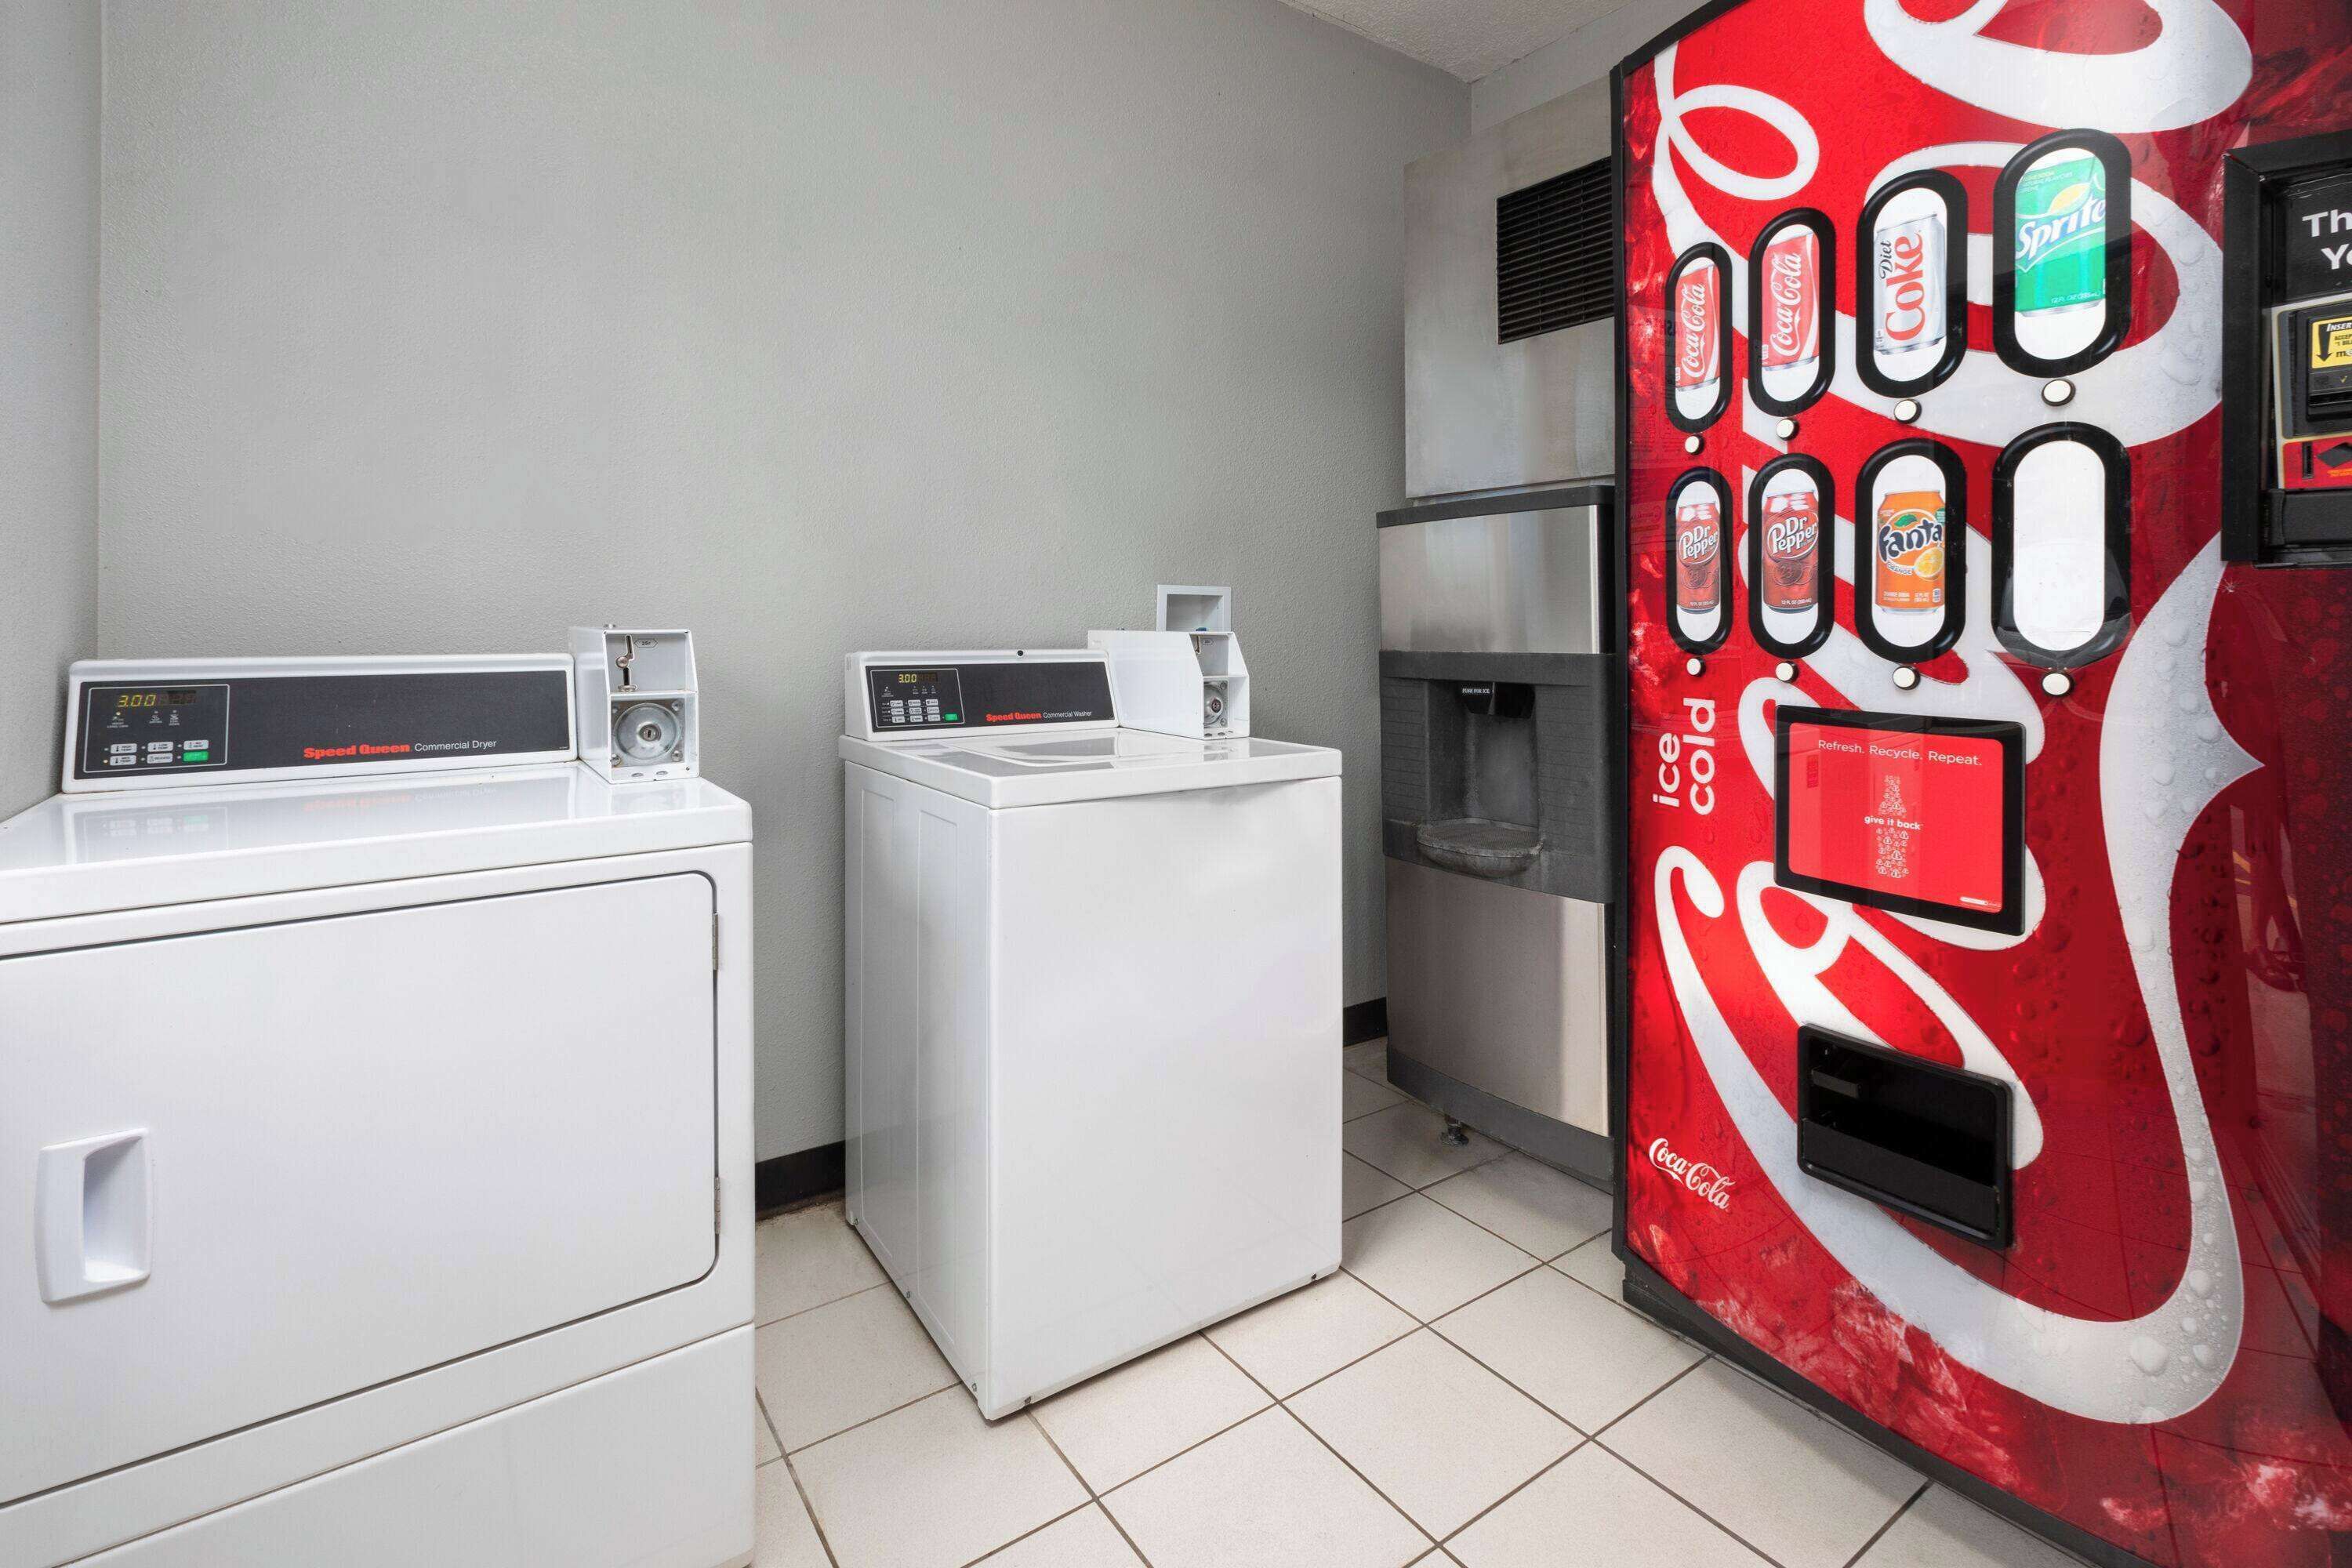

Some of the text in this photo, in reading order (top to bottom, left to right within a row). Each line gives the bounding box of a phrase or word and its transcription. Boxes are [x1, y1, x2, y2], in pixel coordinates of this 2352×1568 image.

[2015, 192, 2106, 260] Sprite
[1878, 240, 1893, 279] Diet
[1885, 230, 1926, 341] Coke
[1693, 525, 1711, 544] Dr
[1767, 522, 1818, 554] Pepper
[1785, 516, 1808, 535] Dr
[1878, 517, 1943, 563] Fanta
[1679, 531, 1719, 560] Pepper
[985, 712, 1014, 722] Speed
[1014, 711, 1042, 720] Queen
[1043, 710, 1073, 719] Commercial
[303, 740, 497, 760] Speed Queen Commercial Dryer
[1682, 697, 1715, 815] cold
[1818, 739, 1982, 766] Refresh. Recycle. Repeat.
[1653, 732, 1681, 808] ice
[1864, 815, 1921, 830] give it back
[1649, 1138, 1736, 1211] Coca-Cola
